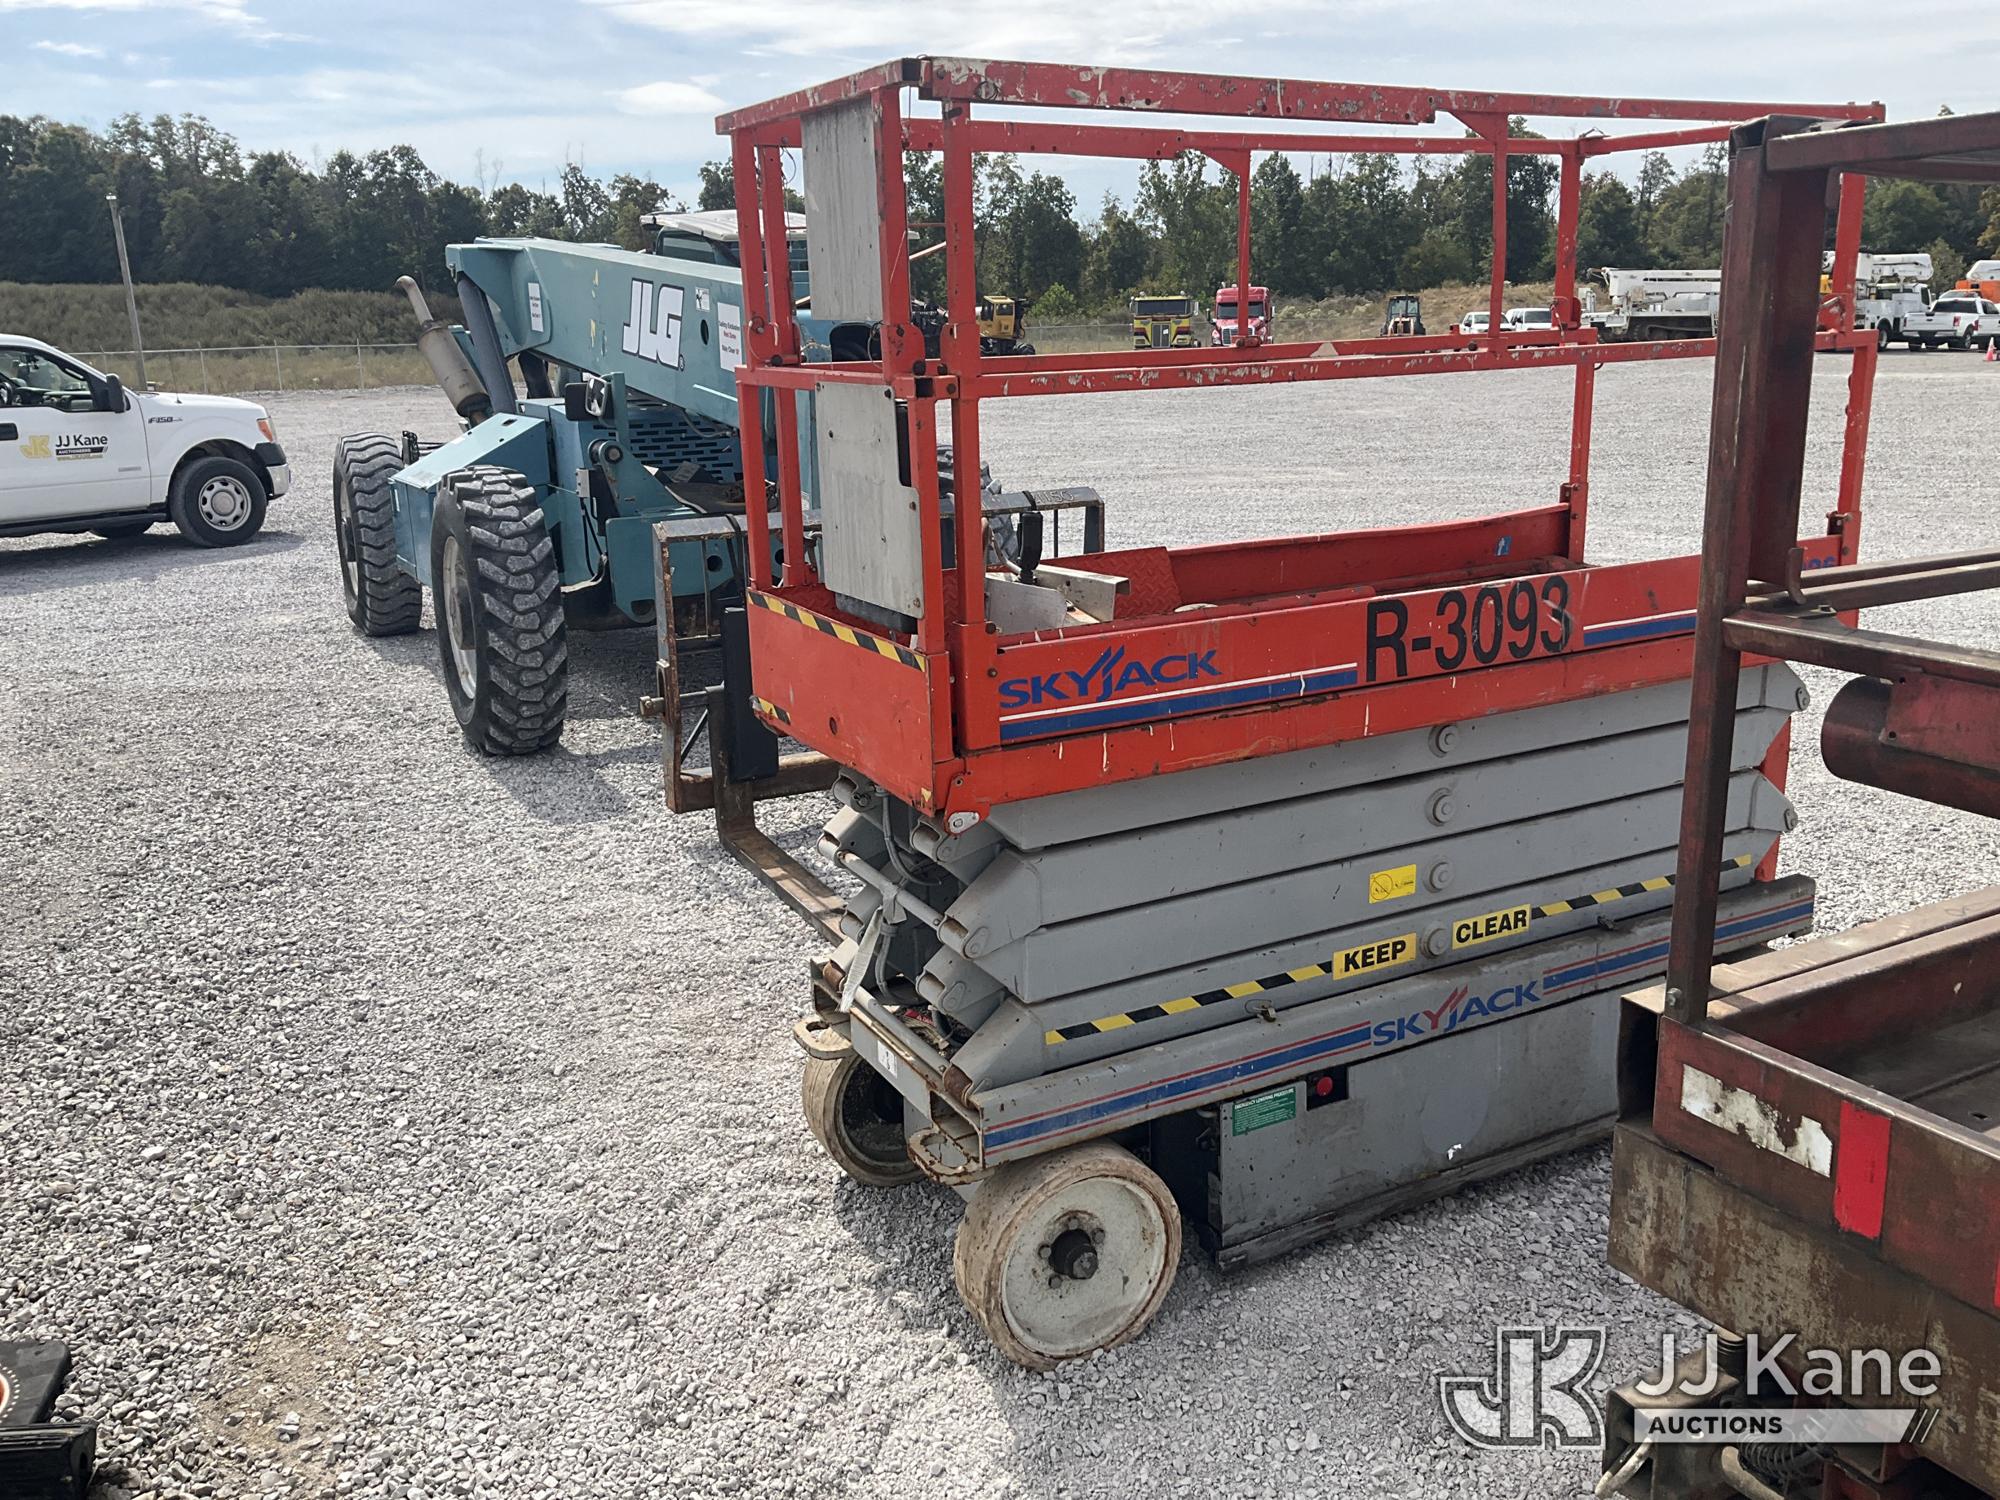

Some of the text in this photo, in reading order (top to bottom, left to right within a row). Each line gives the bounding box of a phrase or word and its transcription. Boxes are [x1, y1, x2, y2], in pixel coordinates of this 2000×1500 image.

[622, 278, 684, 369] JLG
[56, 434, 108, 447] JJ Kane
[1365, 575, 1572, 682] R-3093
[998, 645, 1222, 709] SKYJACK
[1343, 909, 1528, 973] KEEP CLEAR
[1373, 980, 1542, 1047] SKYJACK
